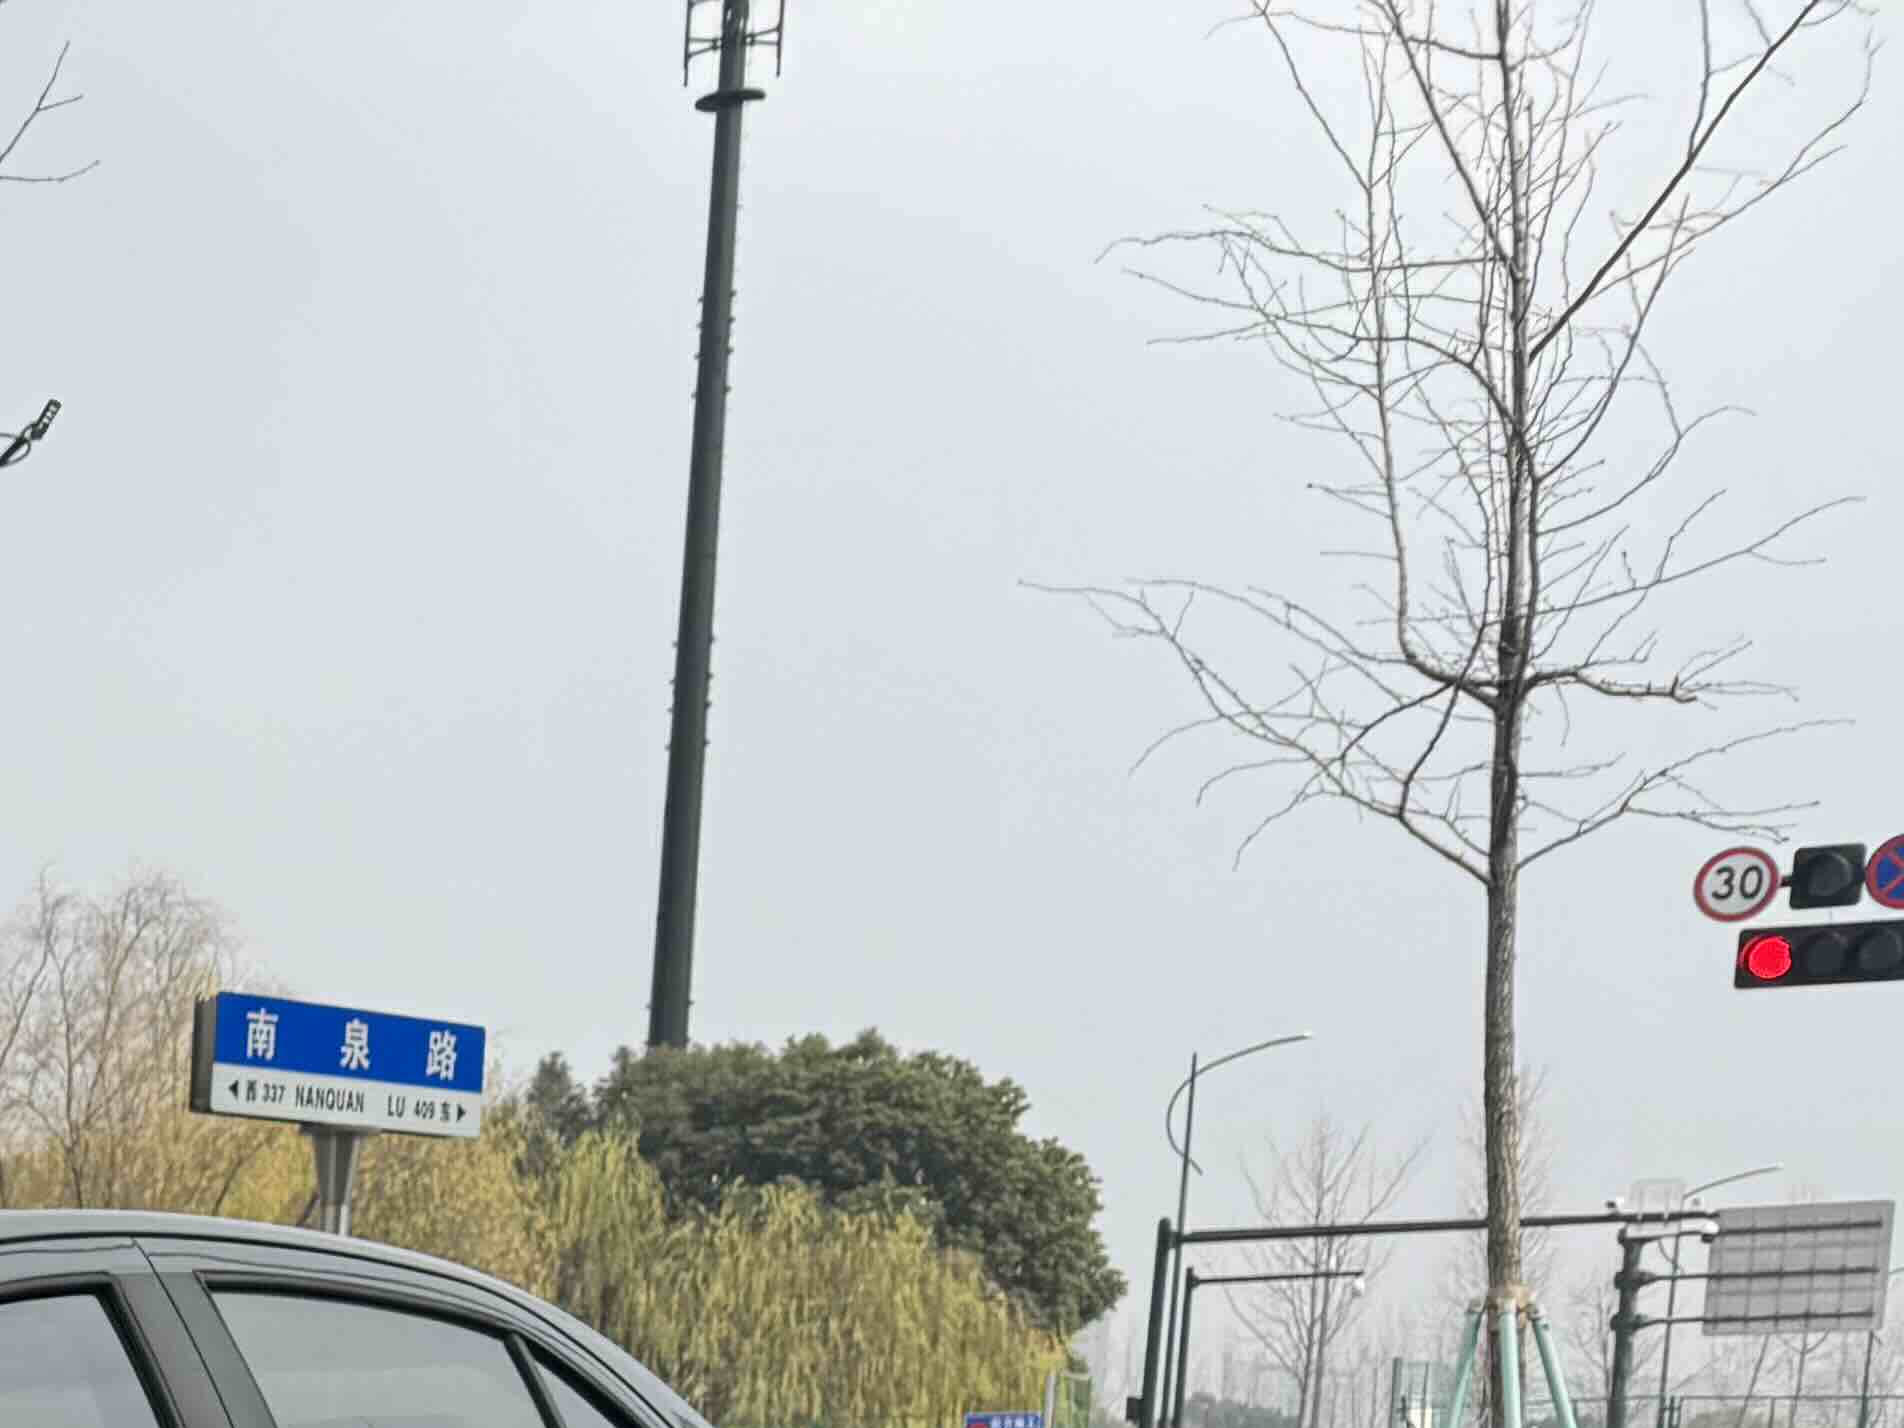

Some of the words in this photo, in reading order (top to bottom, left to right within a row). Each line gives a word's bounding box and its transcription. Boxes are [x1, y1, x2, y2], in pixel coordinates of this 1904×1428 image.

[1711, 864, 1764, 901] 30
[245, 1007, 457, 1081] 南泉路
[295, 1085, 365, 1114] NANQUAN
[387, 1095, 405, 1117] LU
